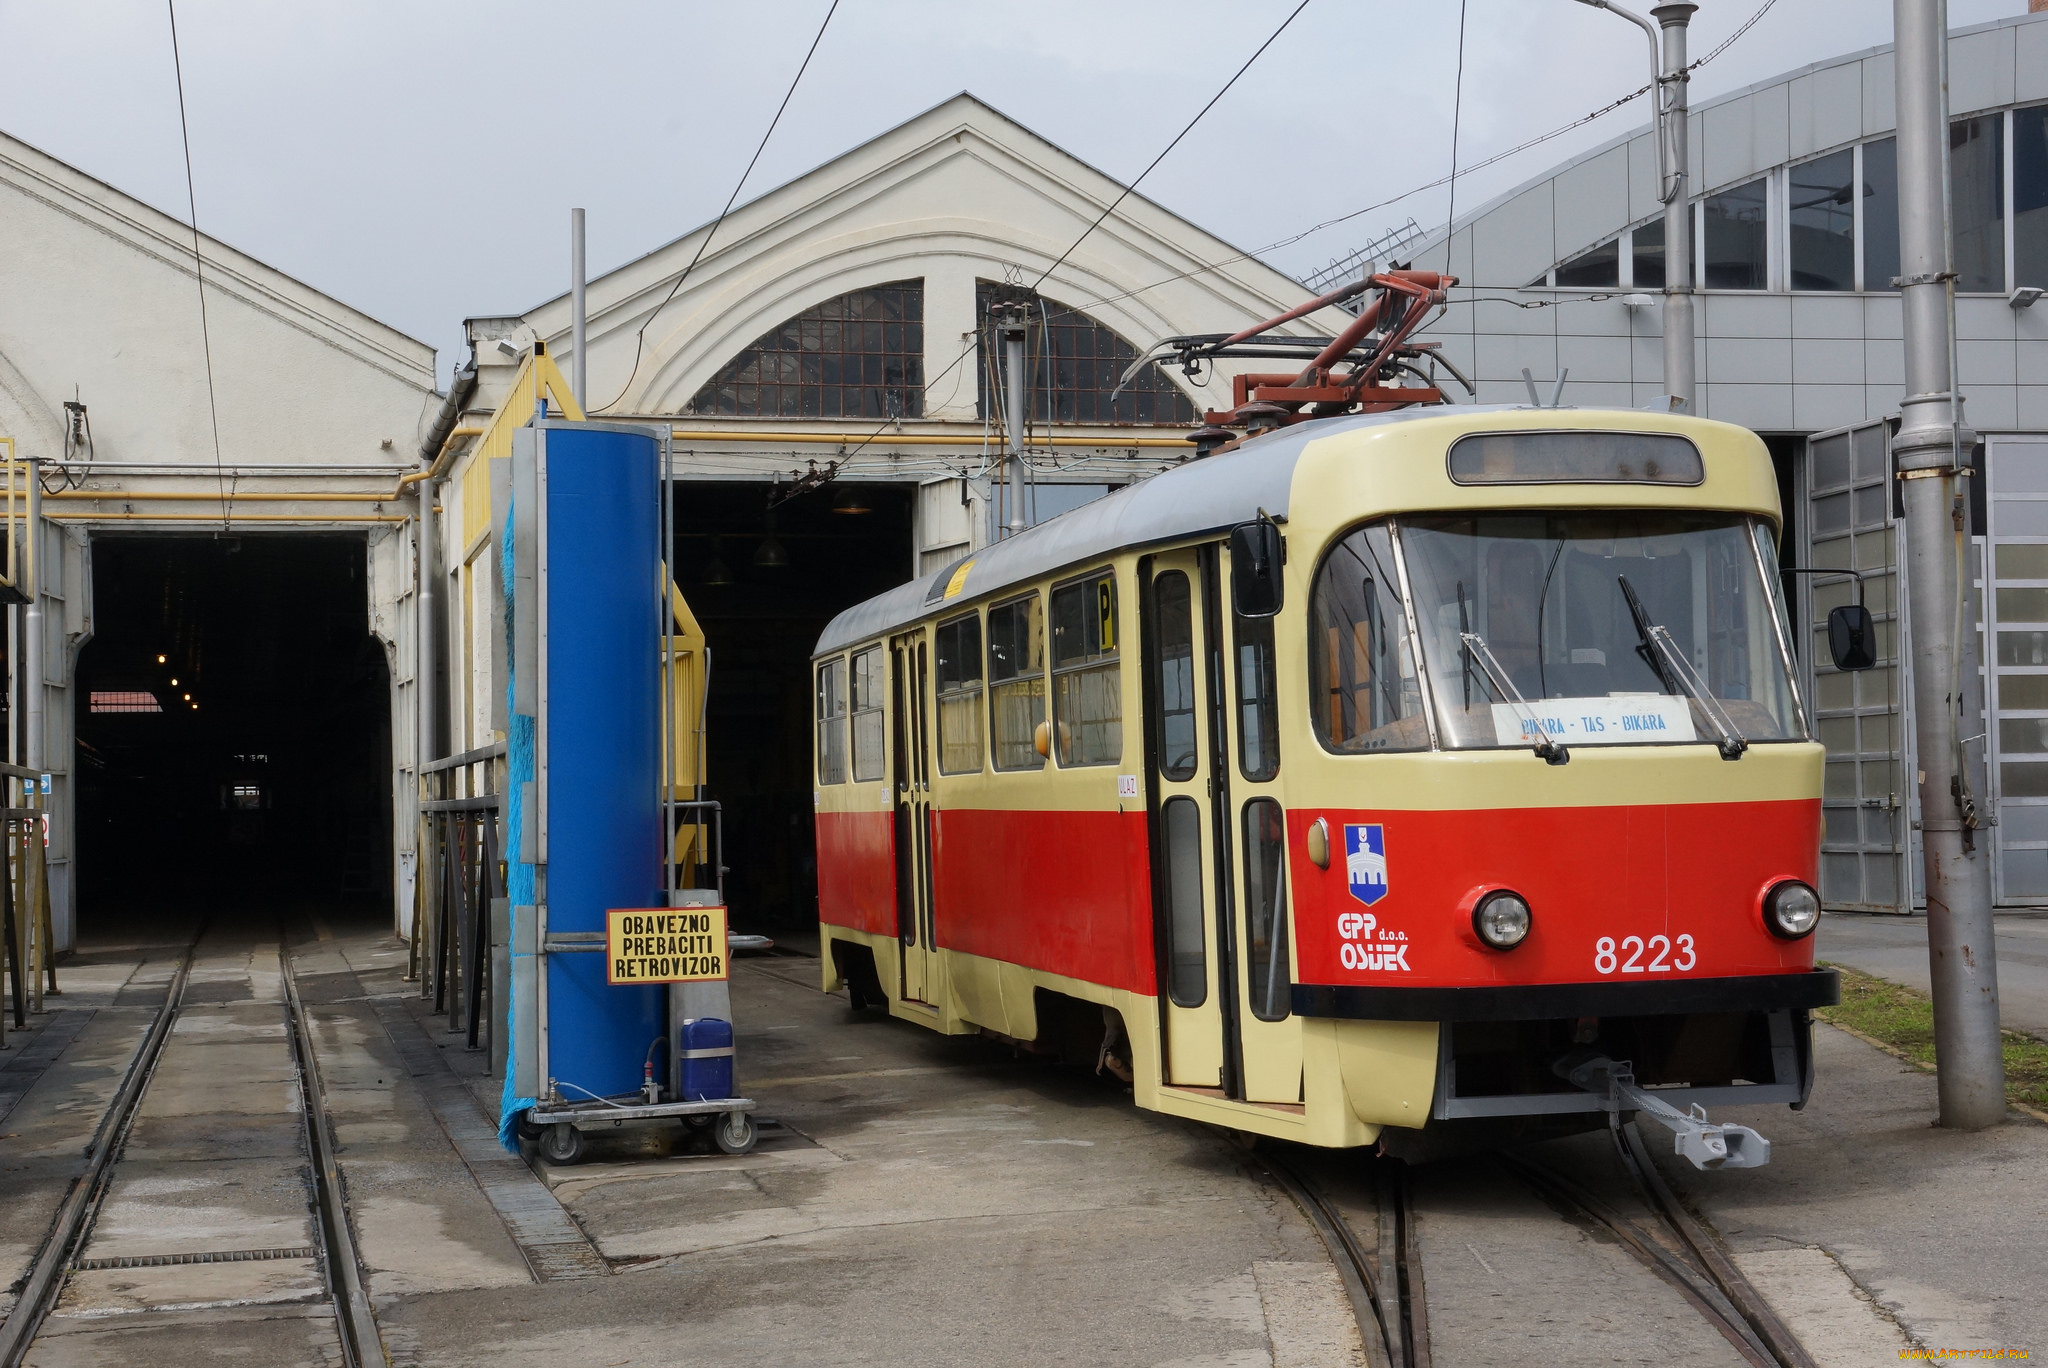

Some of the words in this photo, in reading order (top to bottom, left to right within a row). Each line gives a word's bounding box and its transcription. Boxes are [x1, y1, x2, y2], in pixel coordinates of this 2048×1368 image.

[1581, 716, 1605, 732] TAS
[1622, 714, 1667, 732] BIKARA
[622, 914, 710, 935] OBAVEZNO
[1337, 912, 1377, 940] GPP
[1379, 928, 1409, 941] d.o.o.
[623, 935, 713, 956] PREBACITI
[1594, 933, 1697, 974] 8223
[615, 956, 721, 978] RETROVIZOR
